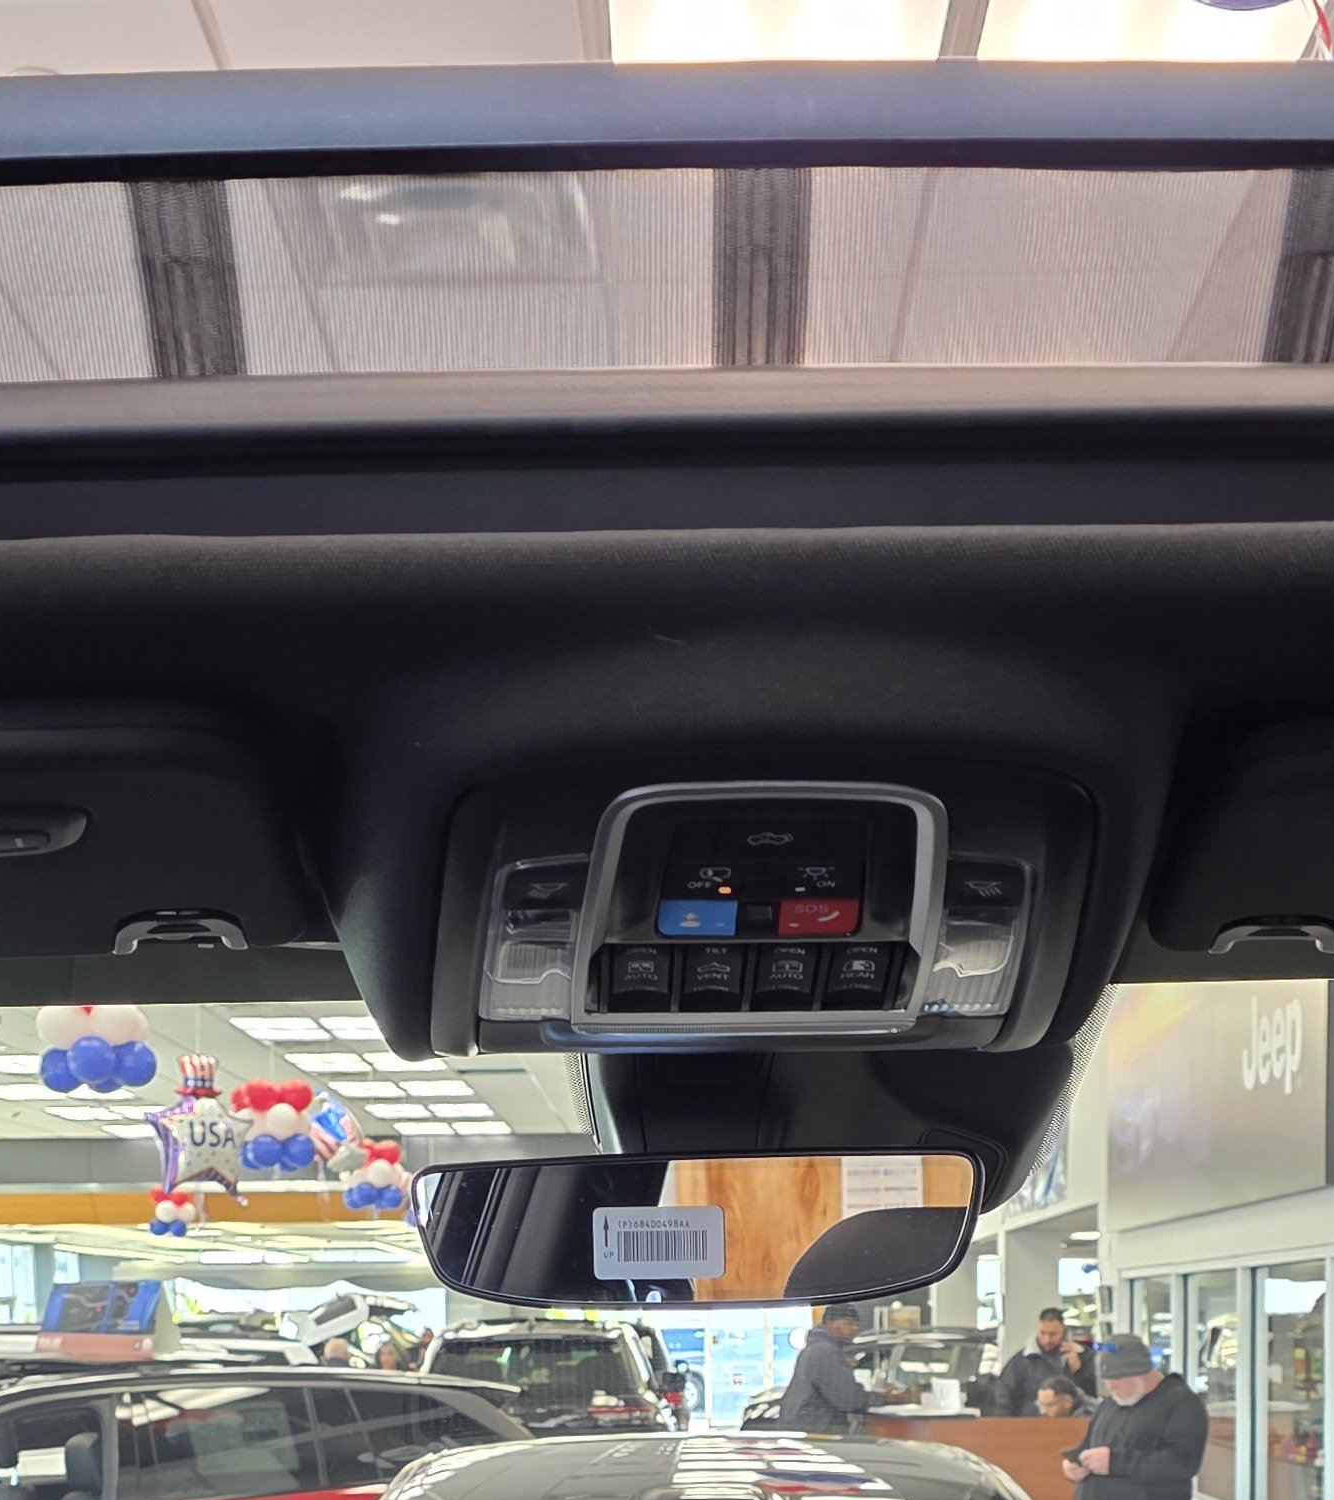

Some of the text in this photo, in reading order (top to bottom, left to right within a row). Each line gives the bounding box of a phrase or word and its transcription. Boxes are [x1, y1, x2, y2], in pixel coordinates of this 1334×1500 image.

[686, 881, 712, 889] OFF
[816, 880, 836, 888] ON
[794, 903, 829, 914] SOS
[704, 947, 728, 955] TILT
[772, 947, 806, 955] OPEN
[845, 946, 878, 955] OPEN
[623, 972, 659, 981] AUTO
[696, 972, 729, 982] VENT
[768, 972, 804, 981] AUTO
[1242, 994, 1304, 1095] Jeep
[189, 1121, 236, 1149] USA
[603, 1251, 615, 1259] UP
